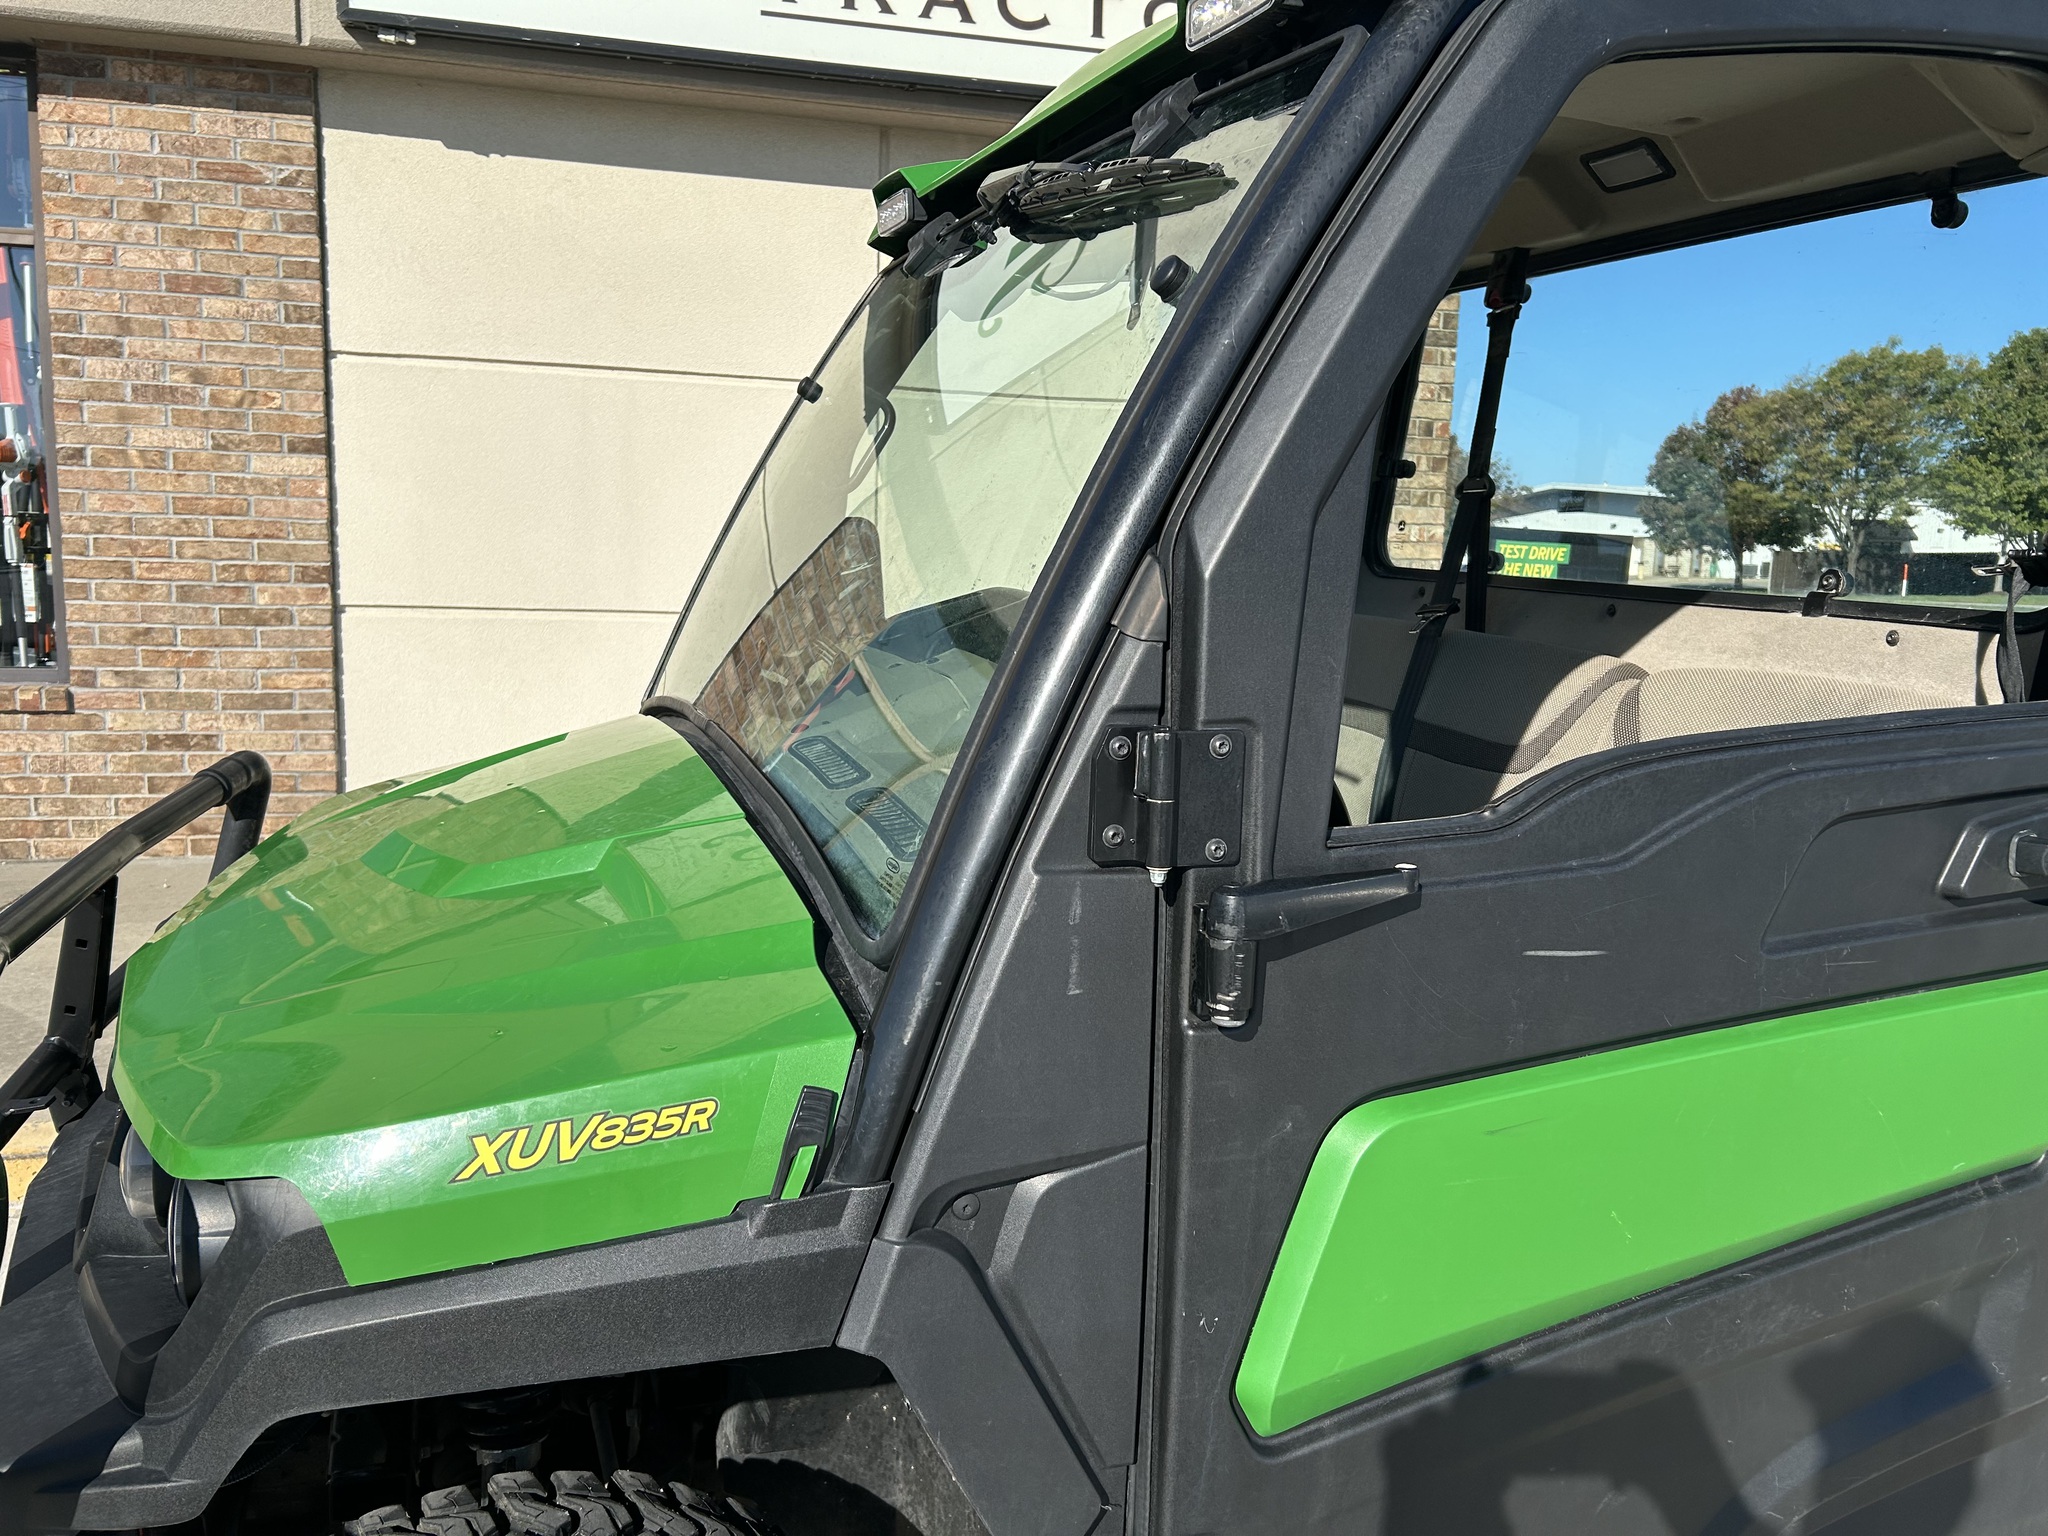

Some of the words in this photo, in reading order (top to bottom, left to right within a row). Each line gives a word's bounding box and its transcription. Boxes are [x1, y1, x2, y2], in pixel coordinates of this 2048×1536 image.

[1499, 543, 1528, 559] TEST
[1529, 545, 1567, 562] DRIVE
[1501, 562, 1522, 577] HE
[1523, 563, 1554, 578] NEW
[449, 1097, 718, 1184] XUV835R
